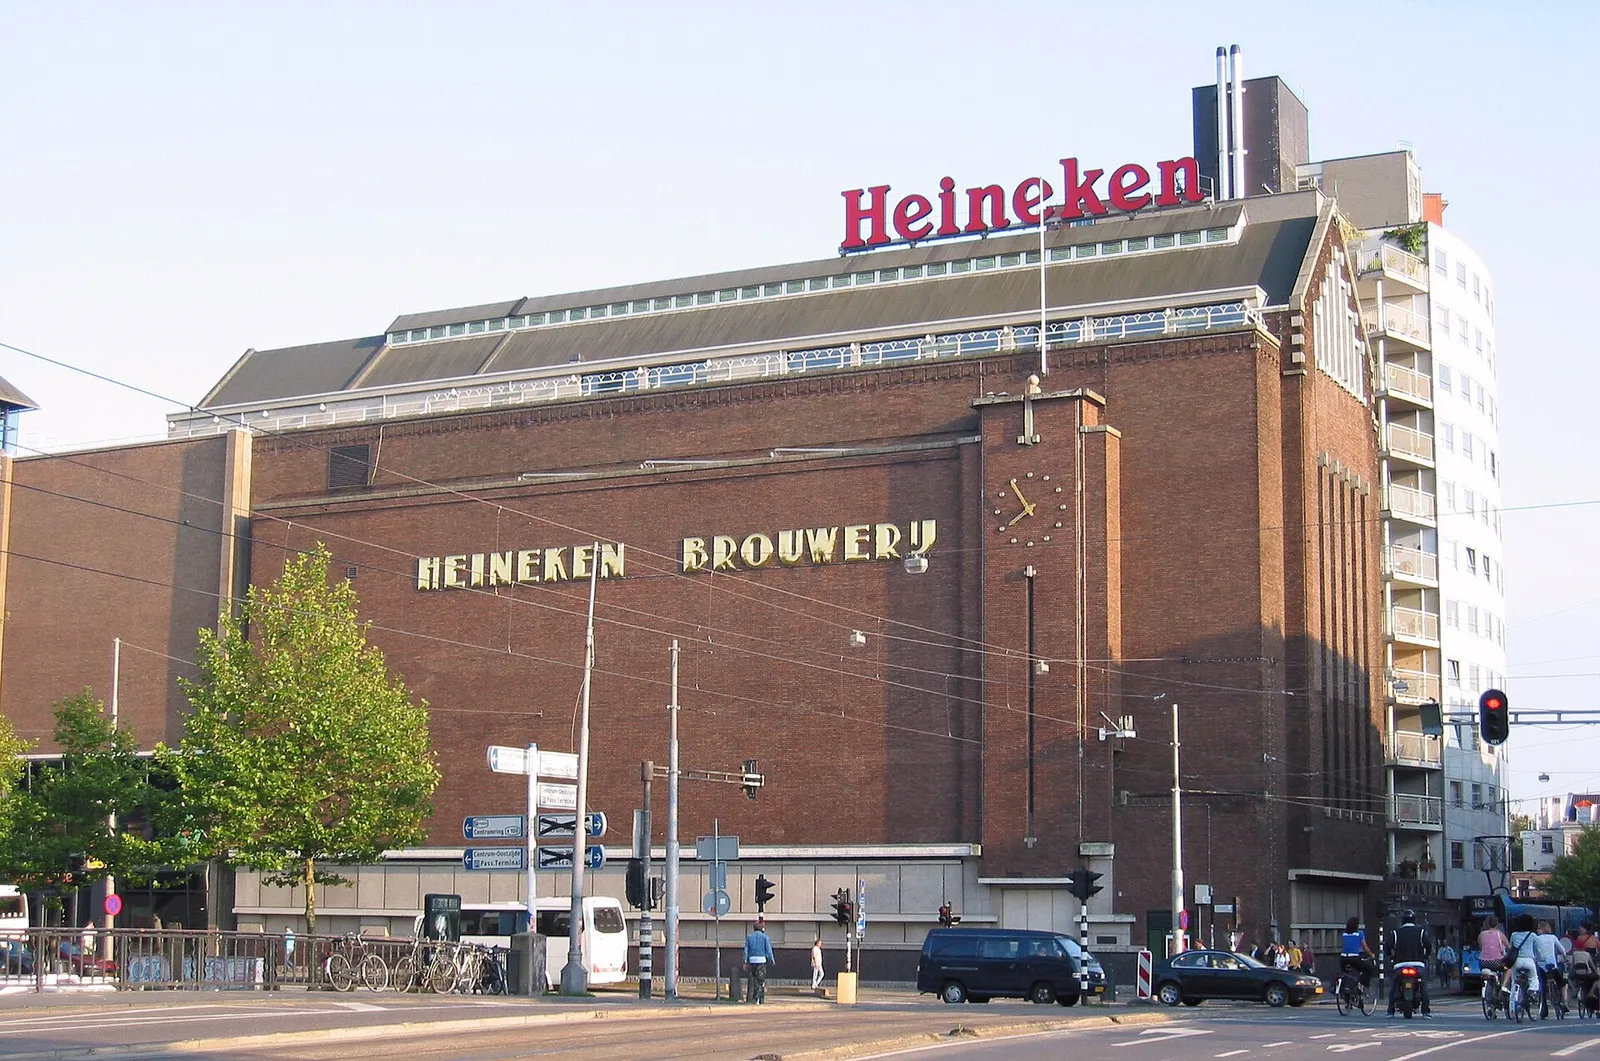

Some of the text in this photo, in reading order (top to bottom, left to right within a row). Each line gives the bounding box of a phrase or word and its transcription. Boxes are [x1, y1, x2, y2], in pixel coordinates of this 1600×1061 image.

[840, 156, 1206, 248] Heineken
[417, 542, 626, 591] HEINEKEN
[1473, 898, 1485, 908] 16
